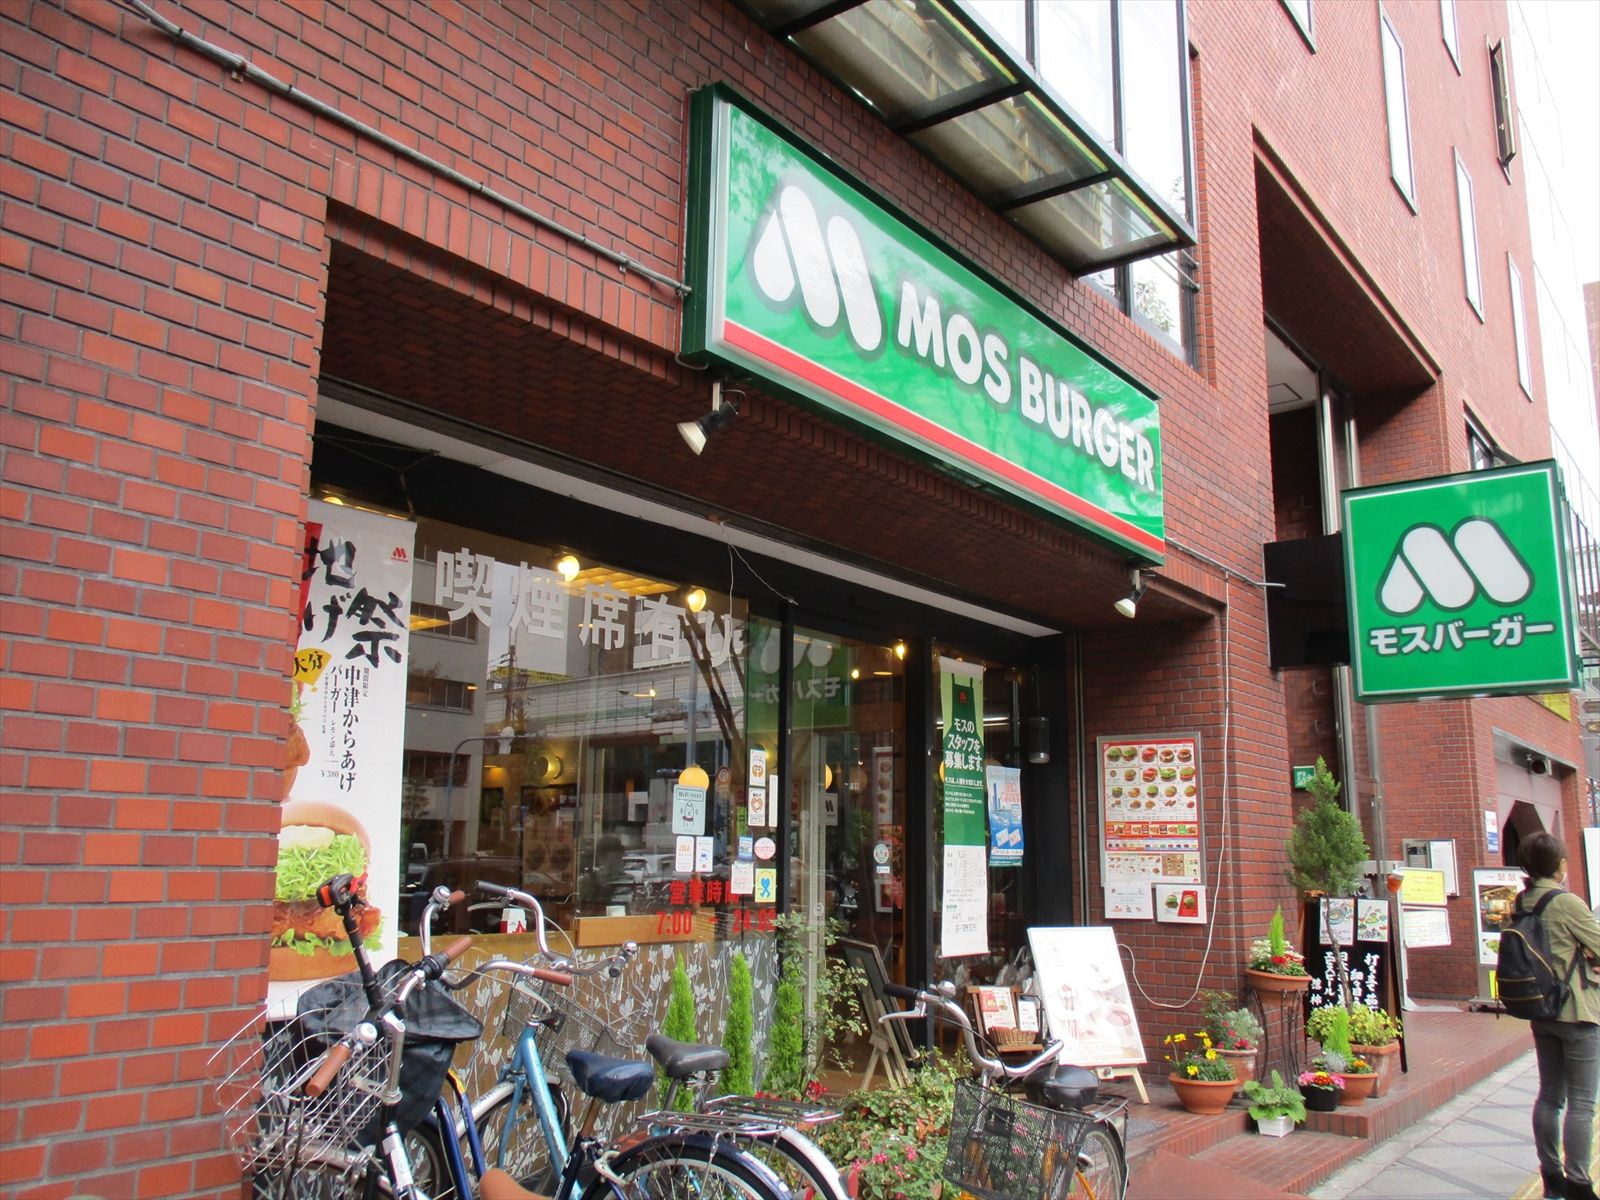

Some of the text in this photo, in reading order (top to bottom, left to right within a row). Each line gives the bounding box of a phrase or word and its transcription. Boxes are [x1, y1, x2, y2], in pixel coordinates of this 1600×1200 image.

[897, 281, 1156, 491] MOS BURGER
[1369, 615, 1555, 655] モスバーガー
[330, 664, 343, 714] バーガー
[340, 665, 361, 793] 中津からあげ
[954, 718, 975, 733] モスの
[948, 734, 981, 754] スタッフを
[944, 751, 983, 773] 募集します。
[656, 911, 692, 935] 7:00
